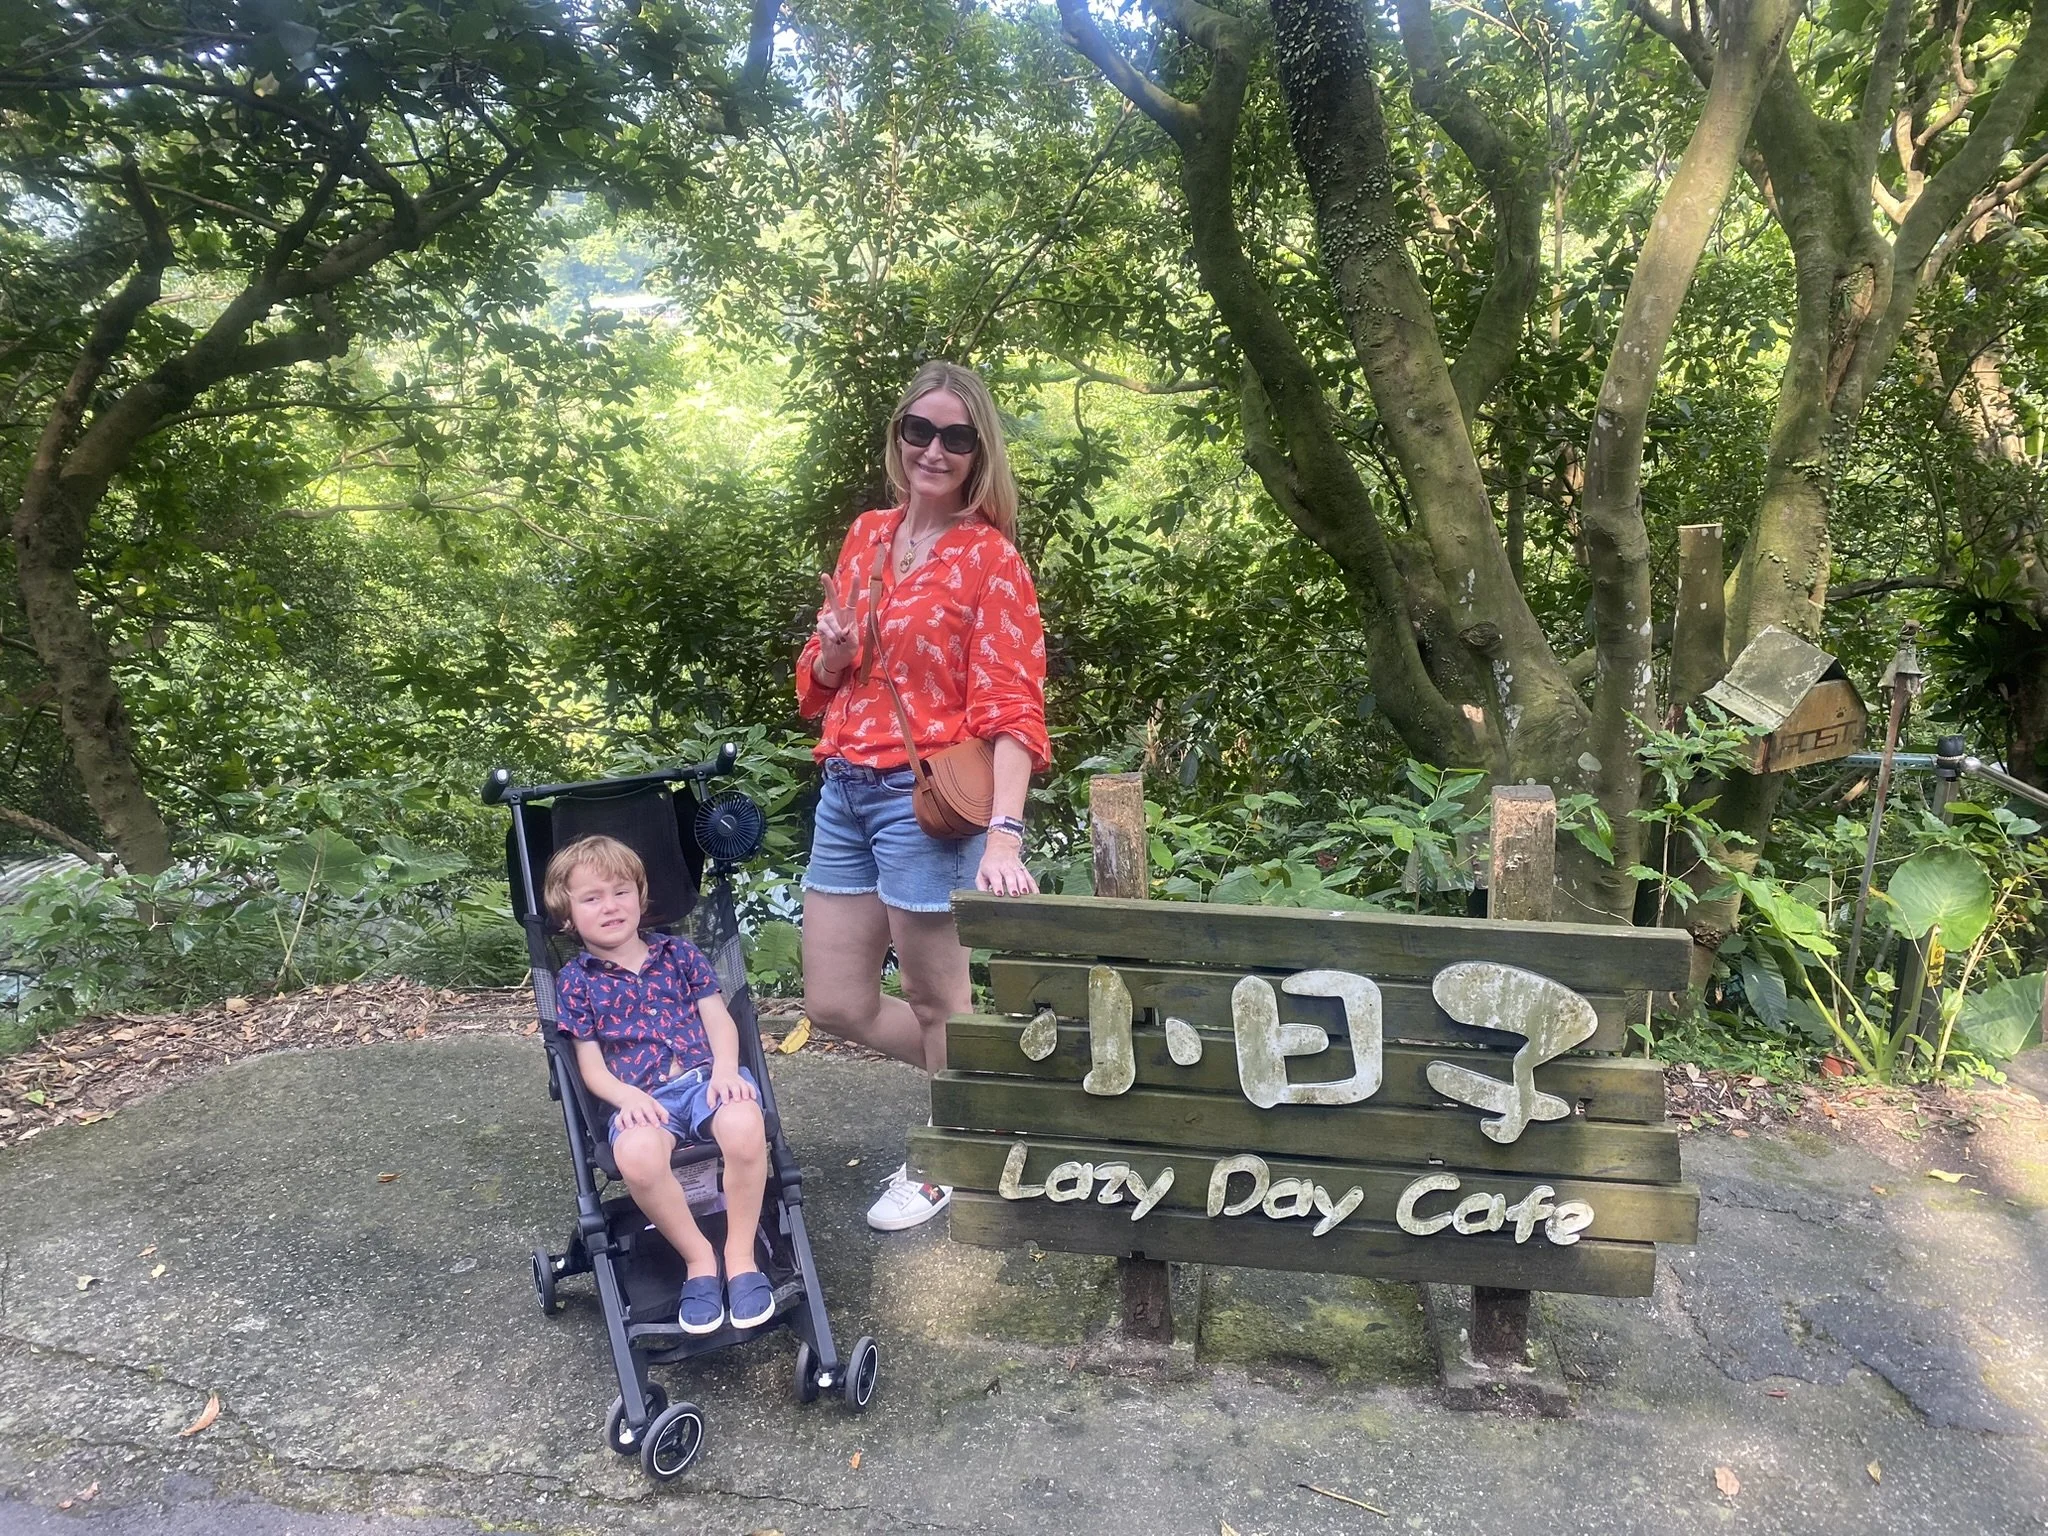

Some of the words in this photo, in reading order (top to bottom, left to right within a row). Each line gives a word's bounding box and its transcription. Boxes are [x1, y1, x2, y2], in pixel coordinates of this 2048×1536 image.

[1019, 961, 1599, 1144] 小日子
[998, 1141, 1176, 1222] Lazy
[1207, 1153, 1365, 1237] Day
[1396, 1172, 1596, 1246] Cafe
